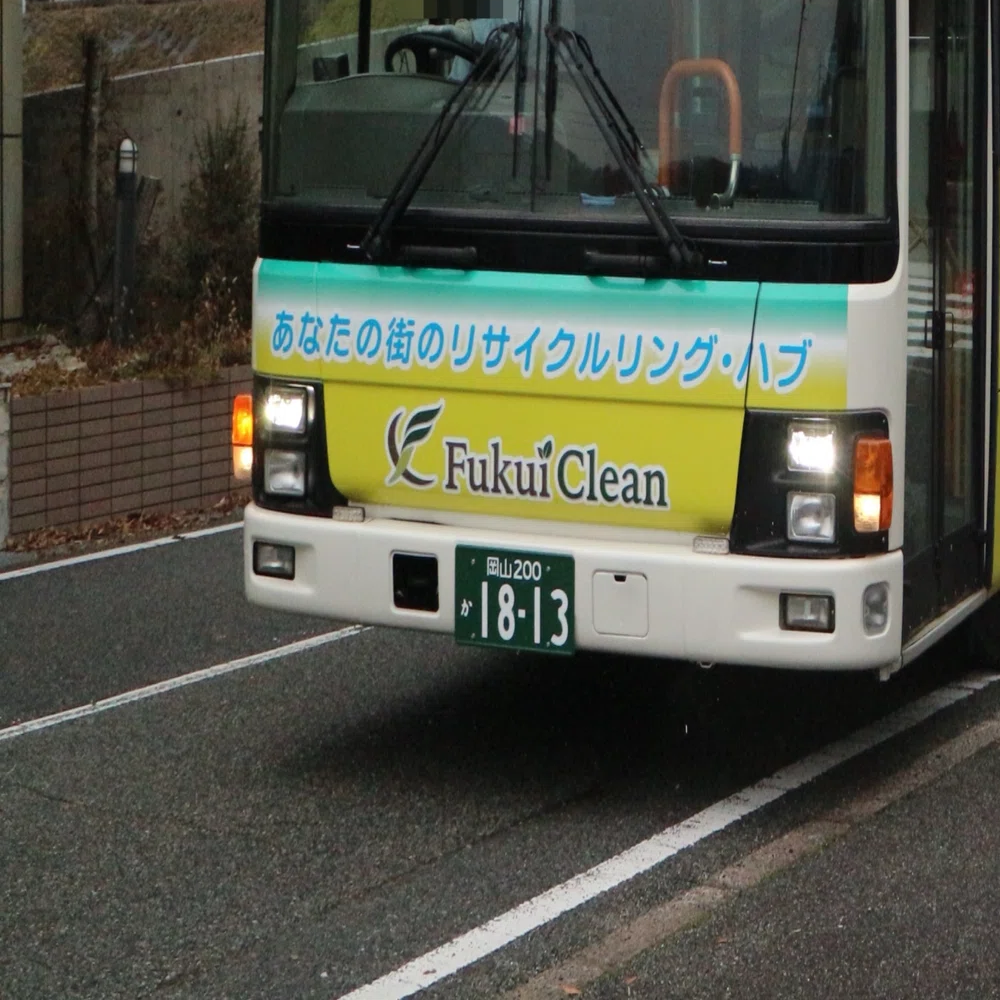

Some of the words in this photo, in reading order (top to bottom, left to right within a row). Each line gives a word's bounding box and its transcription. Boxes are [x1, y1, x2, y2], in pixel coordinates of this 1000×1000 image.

[271, 309, 813, 391] あなたの街のリサイクルリング・ハブ
[445, 436, 552, 497] Fukui
[557, 449, 669, 508] Clean
[481, 581, 569, 646] 18-13
